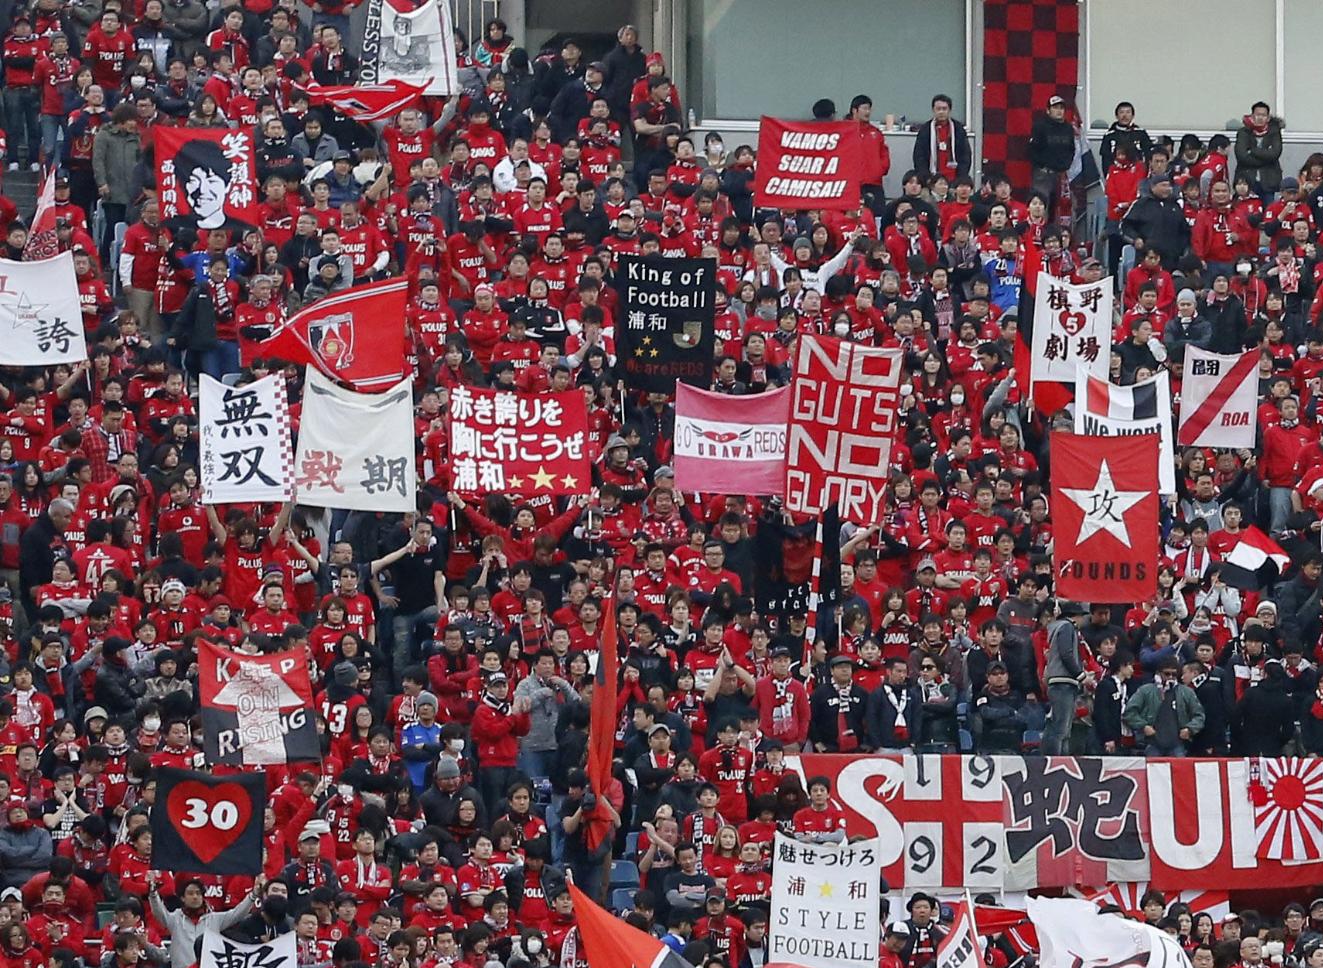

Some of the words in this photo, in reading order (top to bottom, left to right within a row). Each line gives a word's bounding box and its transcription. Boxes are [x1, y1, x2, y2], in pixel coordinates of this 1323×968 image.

[780, 131, 840, 151] VAMOS
[778, 154, 826, 174] SUAR
[764, 175, 847, 198] CAMISA!!
[627, 262, 673, 289] King
[680, 266, 705, 285] of
[627, 287, 706, 309] Football
[627, 309, 669, 333] 浦和
[1065, 316, 1079, 335] 5
[32, 318, 80, 354] 誇
[1043, 334, 1101, 361] 劇場
[797, 335, 902, 394] NO
[451, 388, 561, 426] 赤き誇りを
[793, 377, 898, 433] GUTS
[1220, 411, 1250, 428] ROA
[214, 387, 282, 487] 無双
[451, 427, 583, 463] 胸に行こうぜ
[697, 442, 753, 459] URAWA
[753, 431, 787, 452] REDS
[788, 424, 895, 479] NO
[453, 462, 505, 492] 浦和
[785, 471, 888, 524] GLORY
[1086, 489, 1121, 525] 攻
[215, 655, 297, 684] KEEP
[238, 686, 282, 714] ON
[217, 706, 307, 757] RISING
[180, 797, 239, 831] 30
[778, 841, 877, 868] 魅せつけろ
[778, 906, 867, 931] STYLE
[773, 933, 877, 962] FOOTBALL
